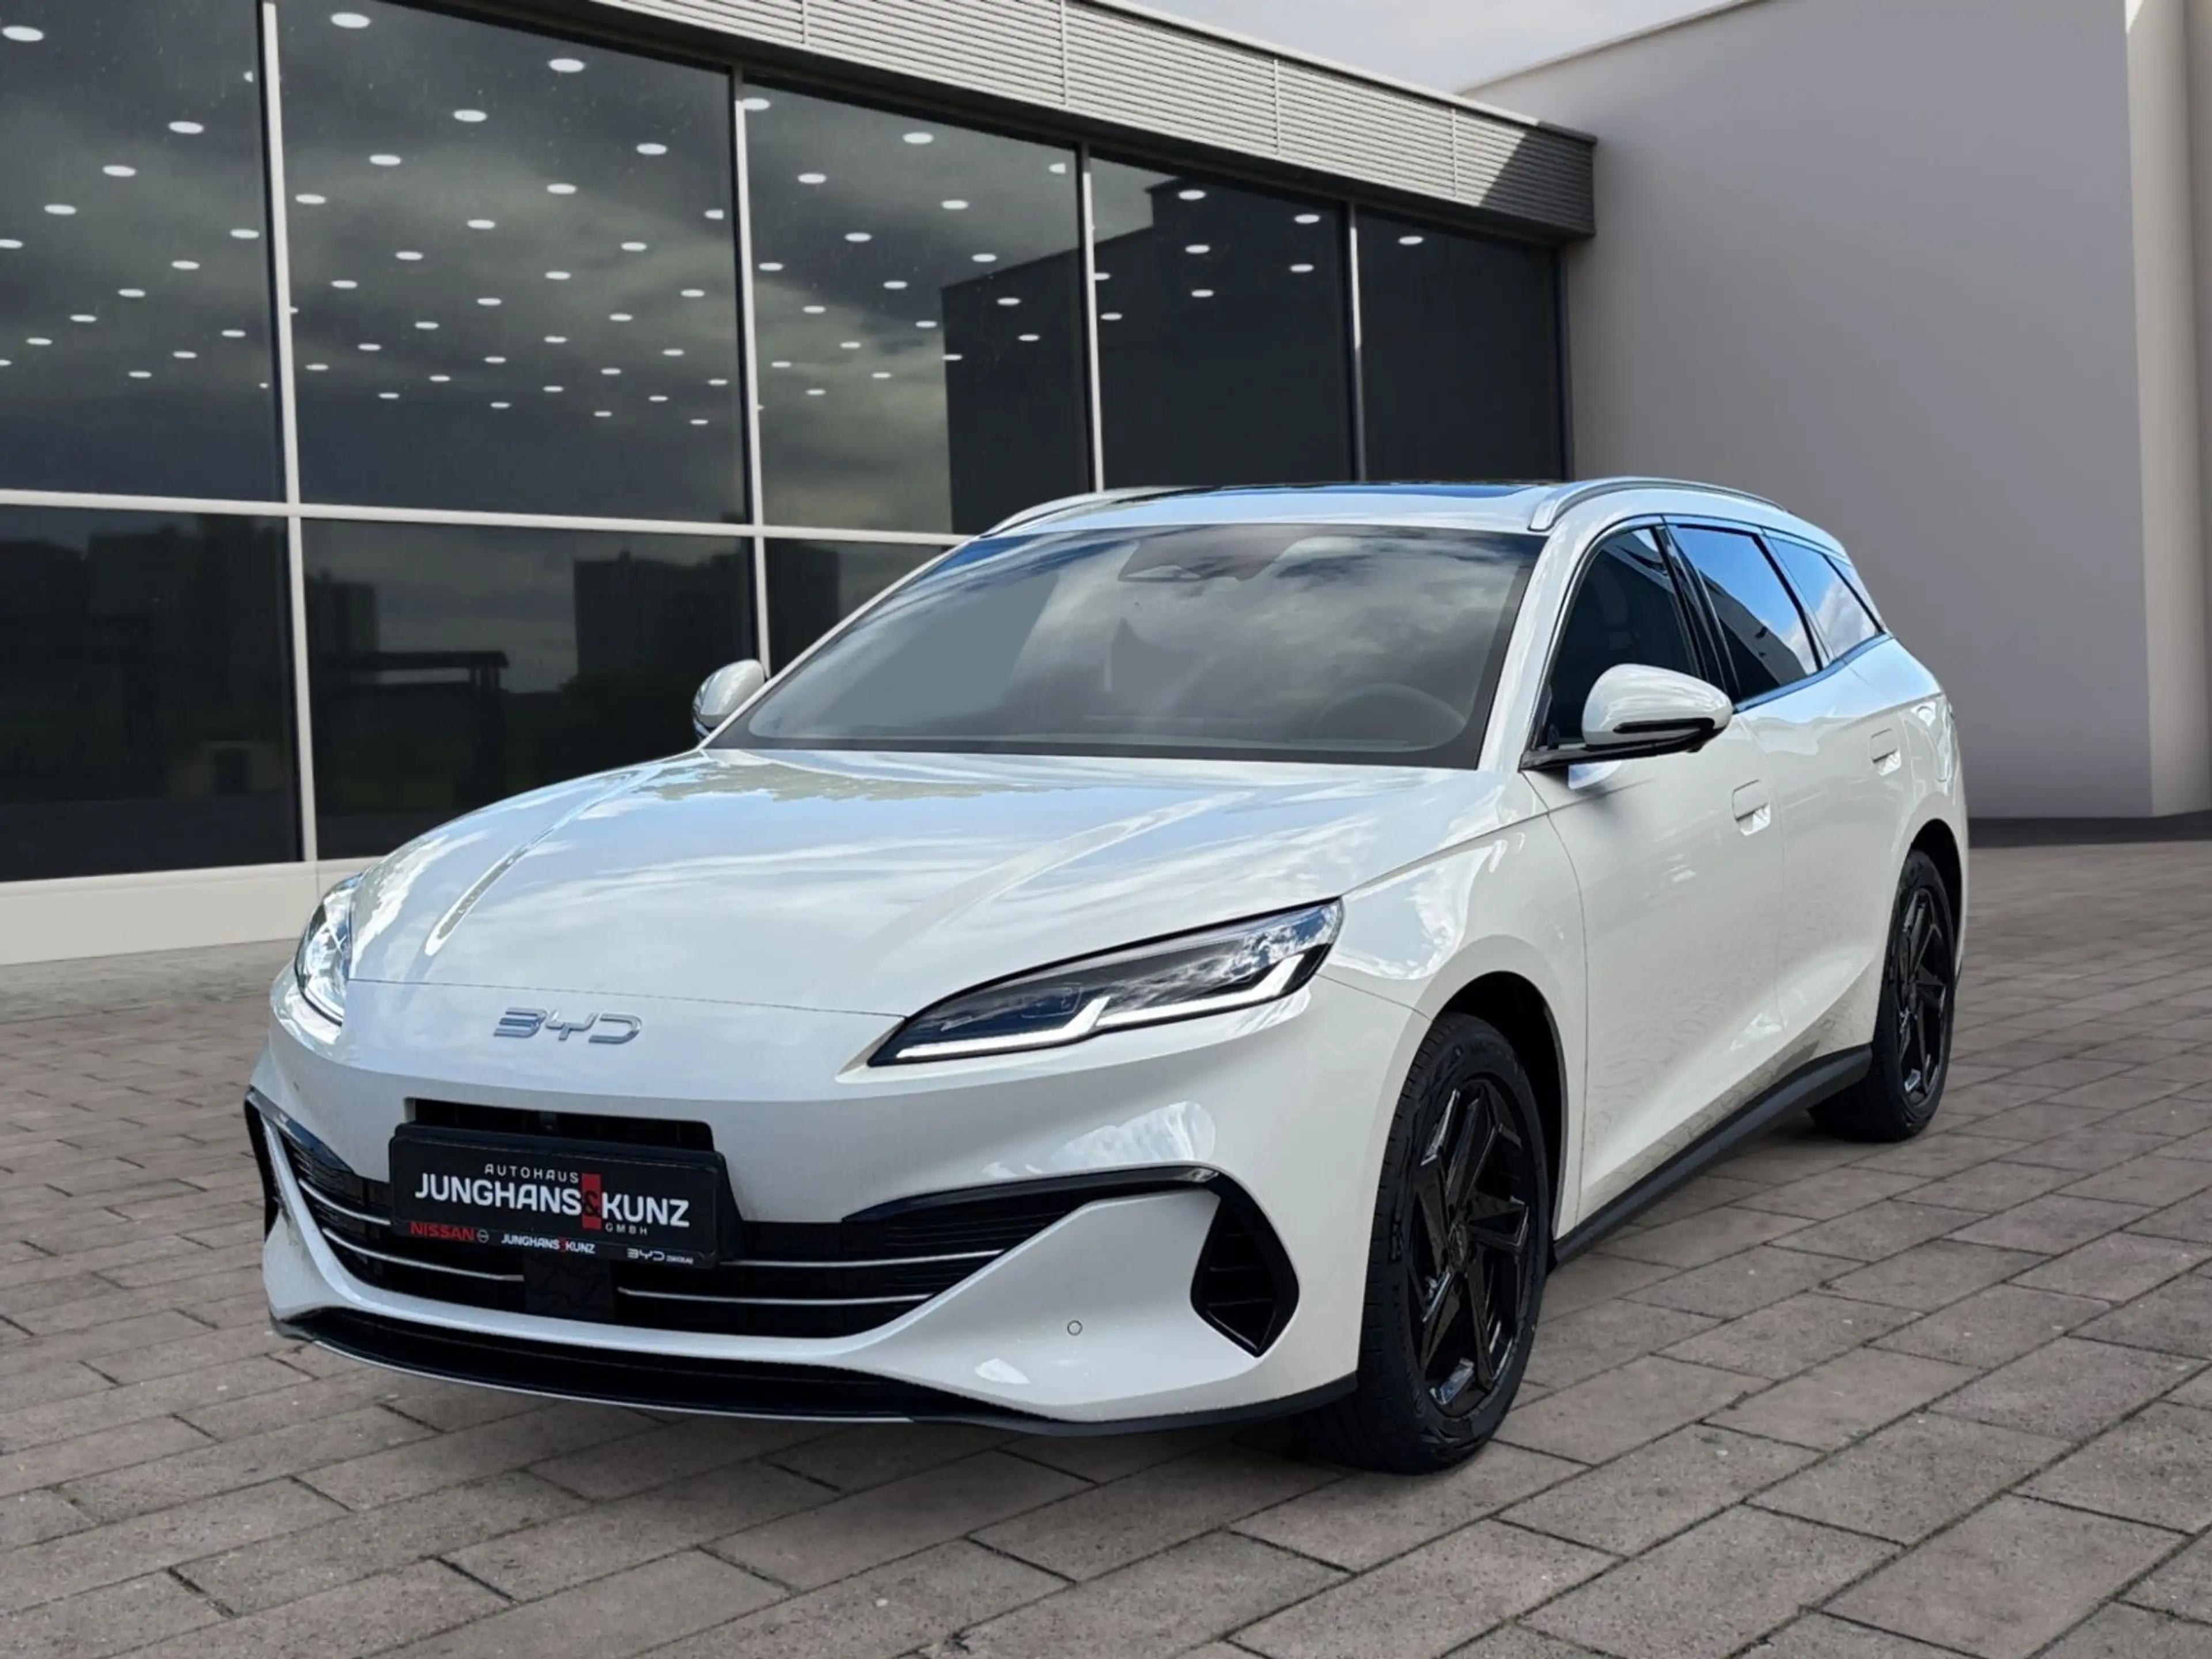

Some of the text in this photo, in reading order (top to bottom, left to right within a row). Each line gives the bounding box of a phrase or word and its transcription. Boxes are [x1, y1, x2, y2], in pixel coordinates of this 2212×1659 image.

[493, 1007, 642, 1044] BYD
[484, 1164, 579, 1184] AUTOHAUS
[410, 1221, 475, 1241] NISSAN
[605, 1222, 647, 1236] GMBH
